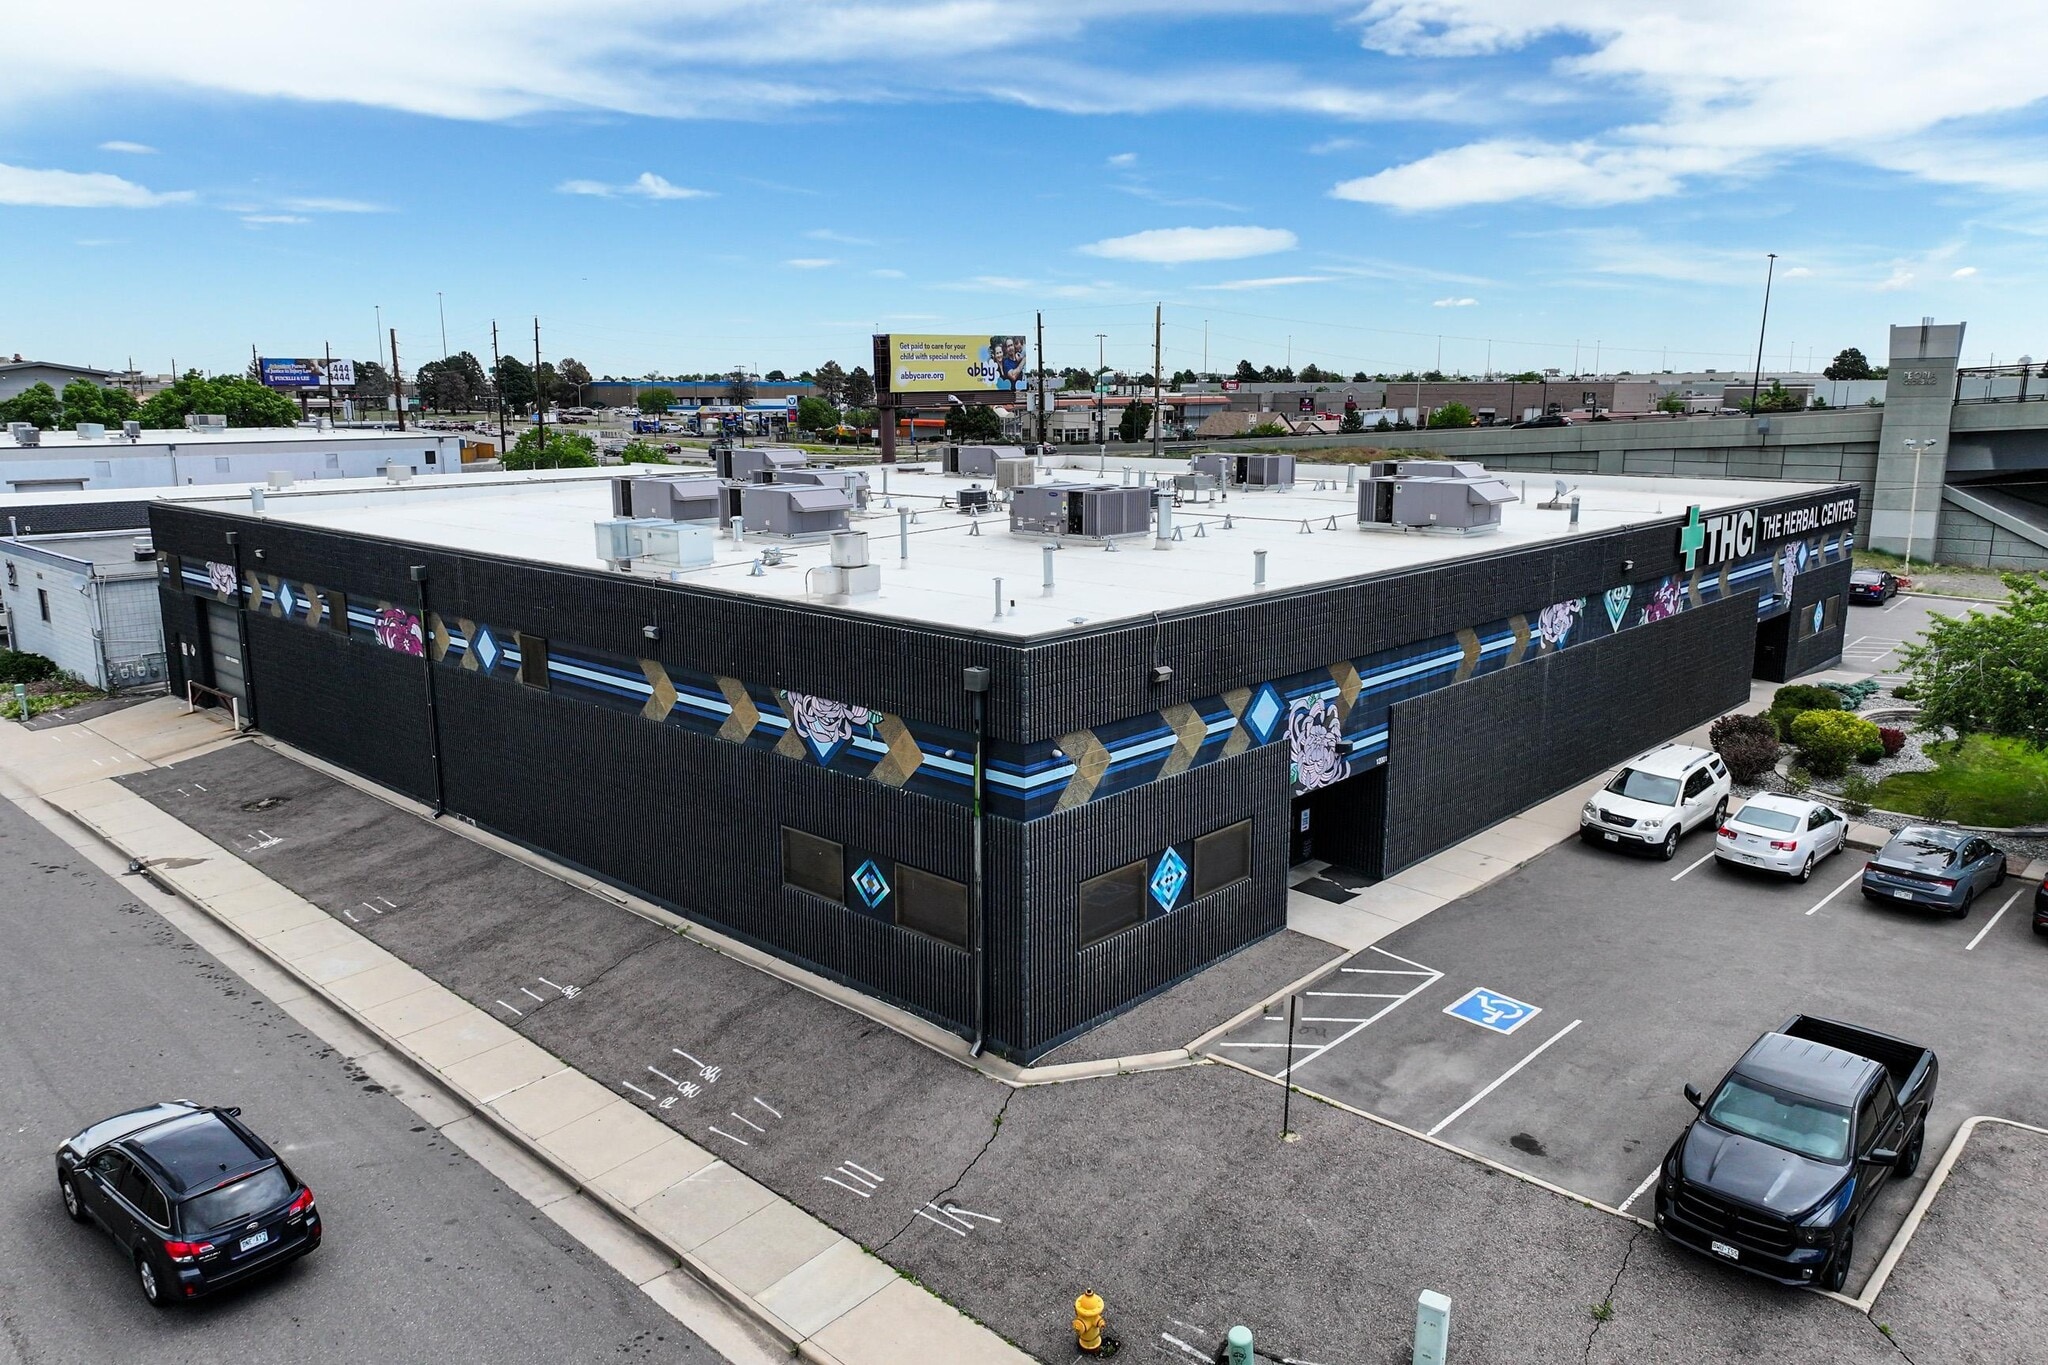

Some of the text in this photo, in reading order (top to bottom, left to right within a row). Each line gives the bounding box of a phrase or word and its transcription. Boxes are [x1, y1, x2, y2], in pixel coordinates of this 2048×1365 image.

[900, 342, 910, 350] Get
[911, 342, 923, 351] paid
[900, 352, 967, 362] child with special needs.
[900, 370, 944, 381] abbycare.org
[967, 362, 995, 381] abby
[1762, 499, 1854, 540] THE HERBAL CENTER
[1706, 510, 1753, 565] THC
